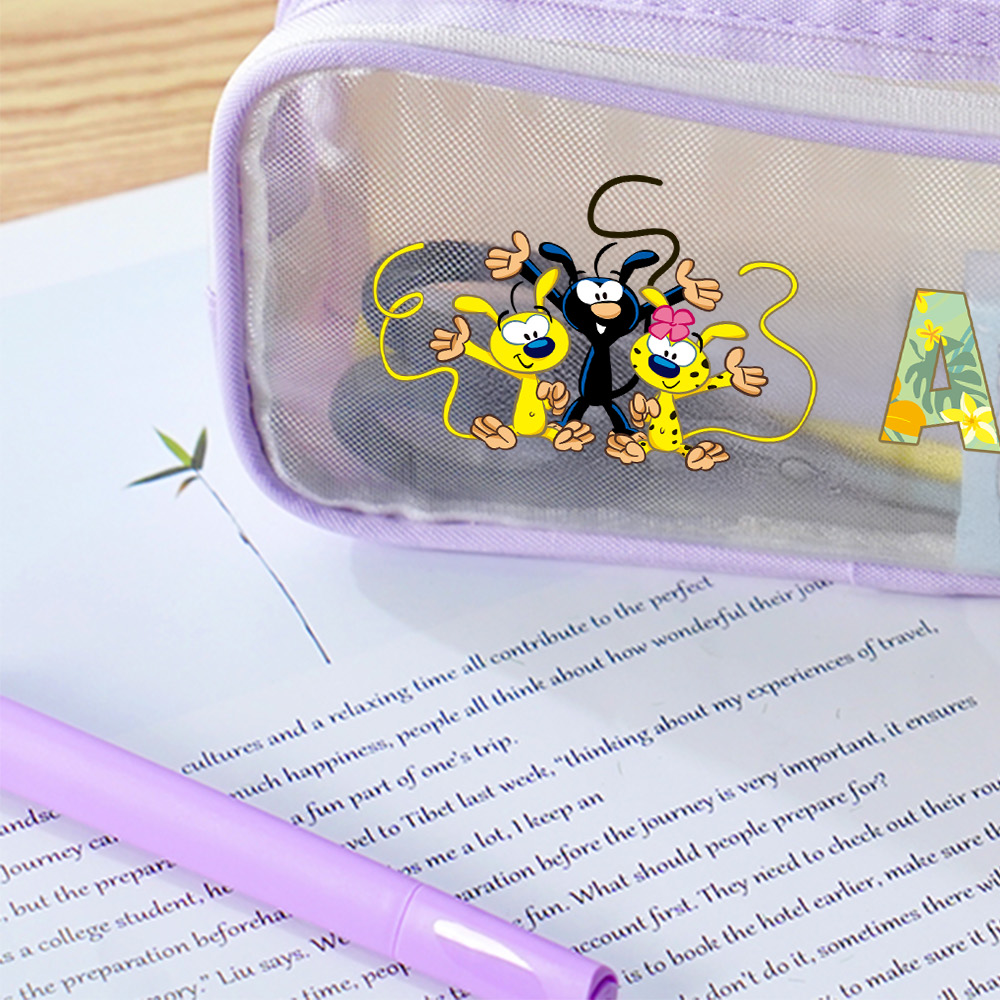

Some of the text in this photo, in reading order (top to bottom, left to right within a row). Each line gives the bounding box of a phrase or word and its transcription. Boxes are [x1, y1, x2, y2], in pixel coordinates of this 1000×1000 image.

[87, 834, 119, 851] ca
[280, 738, 394, 783] happiness,
[394, 708, 459, 748] people
[462, 694, 490, 718] all
[489, 675, 547, 707] think
[548, 655, 606, 687] about
[603, 641, 648, 664] how
[650, 601, 748, 648] wonderful
[747, 590, 796, 613] their
[797, 578, 834, 602] jou
[180, 738, 264, 775] cultures
[266, 717, 308, 747] and
[310, 718, 325, 731] a
[327, 686, 414, 724] relaxing
[411, 668, 456, 693] time
[460, 652, 487, 675] all
[488, 621, 587, 665] contribute
[588, 613, 612, 628] to
[612, 600, 644, 620] the
[647, 575, 713, 611] perfect
[7, 894, 50, 917] but
[52, 884, 89, 904] the
[289, 812, 304, 827] a
[304, 798, 346, 827] fun
[347, 777, 392, 810] part
[395, 763, 417, 791] of
[419, 749, 472, 778] one's
[471, 735, 519, 758] trip.
[18, 945, 34, 958] a
[36, 920, 110, 952] college
[114, 890, 205, 929] student,
[340, 826, 377, 850] vel
[376, 822, 401, 840] to
[398, 798, 456, 829] Tibet
[454, 783, 496, 809] last
[497, 762, 556, 793] week,
[652, 702, 710, 736] about
[710, 693, 743, 712] my
[745, 653, 855, 700] experiences
[856, 636, 878, 662] of
[876, 618, 939, 651] travel,
[214, 965, 256, 985] Liu
[257, 948, 311, 973] says.
[452, 864, 536, 903] aration
[533, 838, 602, 872] before
[601, 824, 637, 846] the
[636, 795, 714, 840] journey
[714, 787, 736, 803] is
[735, 770, 779, 794] very
[778, 729, 887, 778] important,
[882, 720, 903, 738] it
[904, 695, 978, 731] ensures
[523, 902, 571, 932] fun.
[567, 872, 630, 905] What
[632, 840, 702, 883] should
[703, 818, 769, 860] people
[770, 791, 848, 834] prepare
[846, 770, 888, 806] for?
[647, 896, 699, 933] first.
[694, 877, 749, 904] They
[751, 850, 802, 884] need
[800, 848, 825, 865] to
[826, 821, 884, 855] check
[884, 808, 920, 833] out
[918, 791, 967, 819] their
[18, 791, 605, 1000] the preparation beforeha me a lot, I keep an
[620, 968, 643, 985] is
[642, 959, 667, 977] to
[664, 933, 721, 966] book
[720, 922, 757, 945] the
[754, 895, 811, 930] hotel
[812, 875, 884, 910] earlier,
[882, 851, 939, 881] make
[939, 834, 984, 860] sure
[704, 969, 760, 1000] don't
[761, 958, 790, 981] do
[788, 949, 817, 968] it,
[815, 908, 922, 959] sometimes
[920, 886, 975, 915] there
[837, 982, 863, 999] to
[863, 957, 921, 989] make
[922, 939, 968, 965] sure
[965, 928, 987, 947] it
